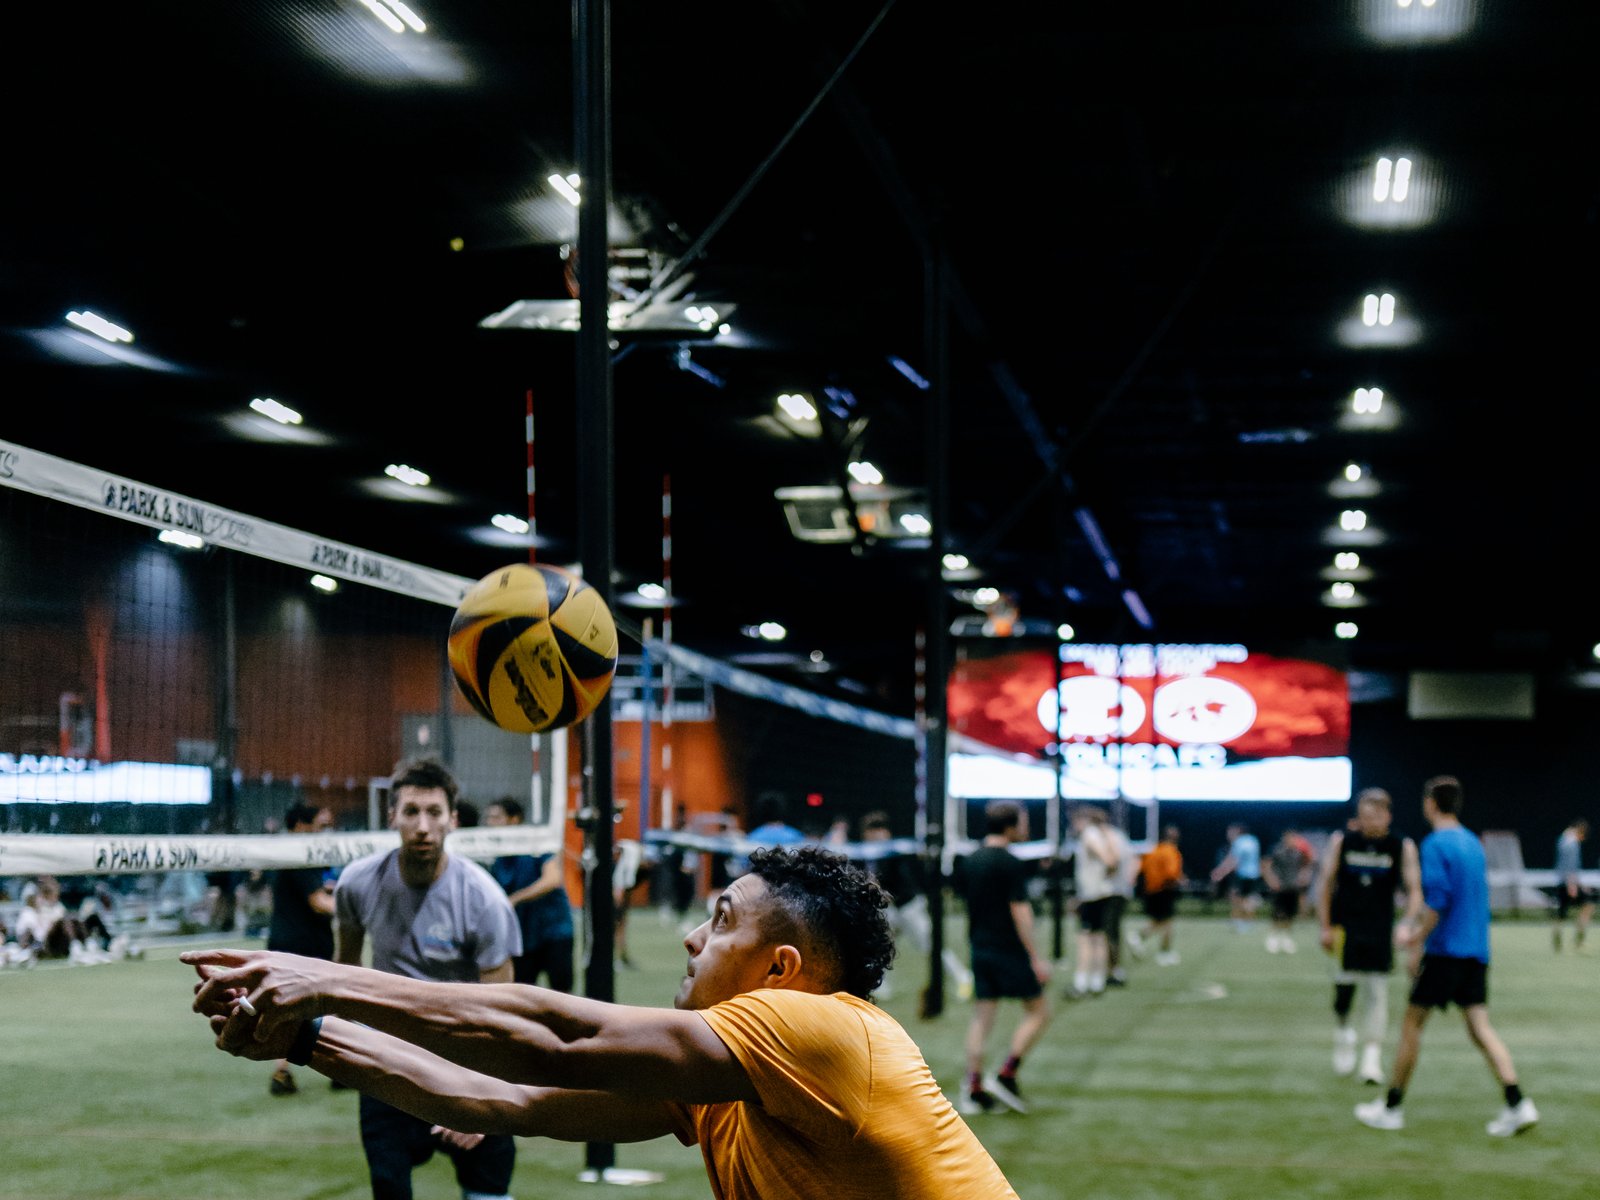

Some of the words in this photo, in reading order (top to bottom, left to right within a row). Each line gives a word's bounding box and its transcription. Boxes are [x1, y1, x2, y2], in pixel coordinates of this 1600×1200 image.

[119, 484, 159, 521] PARK
[162, 498, 172, 524] &
[175, 502, 205, 534] SUN
[110, 839, 150, 870] PARK
[154, 846, 165, 868] &
[168, 841, 199, 868] SUN
